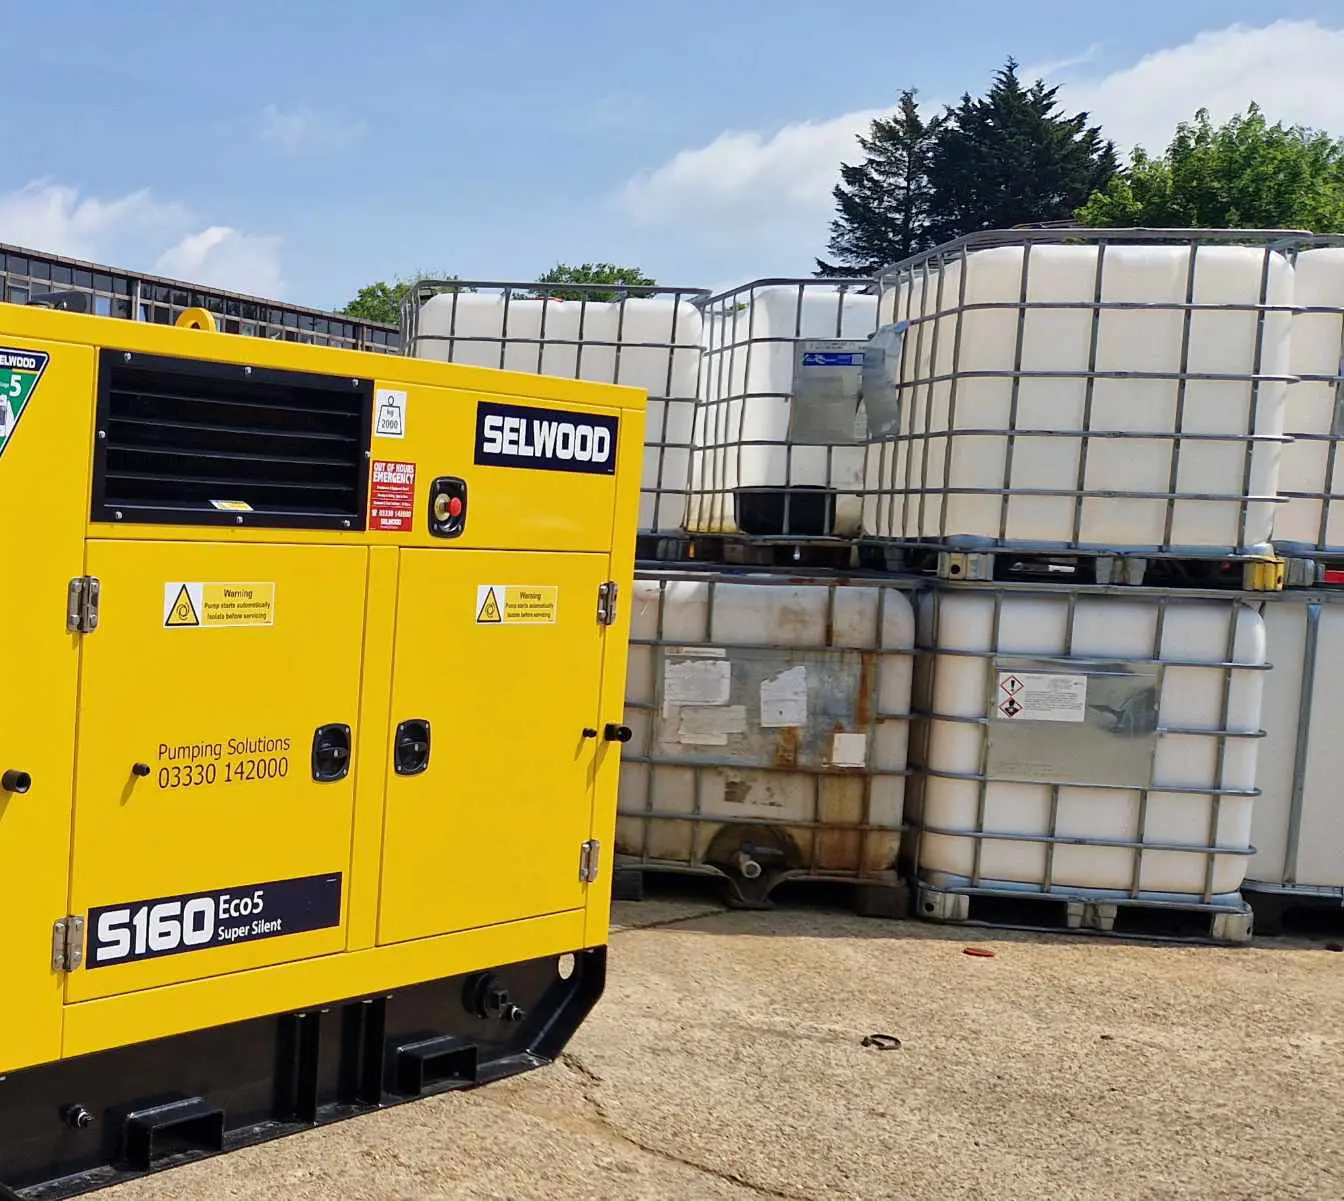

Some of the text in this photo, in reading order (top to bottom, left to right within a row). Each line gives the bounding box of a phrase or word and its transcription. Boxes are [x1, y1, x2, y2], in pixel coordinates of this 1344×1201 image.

[9, 374, 22, 397] 5
[382, 419, 398, 429] 2000
[483, 415, 610, 463] SELWOOD
[373, 471, 415, 484] EMERGENCY
[374, 462, 414, 473] OUT OF HOURS
[224, 588, 253, 600] Warning
[204, 602, 220, 610] Pump
[158, 735, 291, 763] Pumping Solutions
[158, 757, 289, 789] 03330 142000
[96, 890, 264, 961] S160 Eco5
[218, 918, 282, 943] Super Silent
